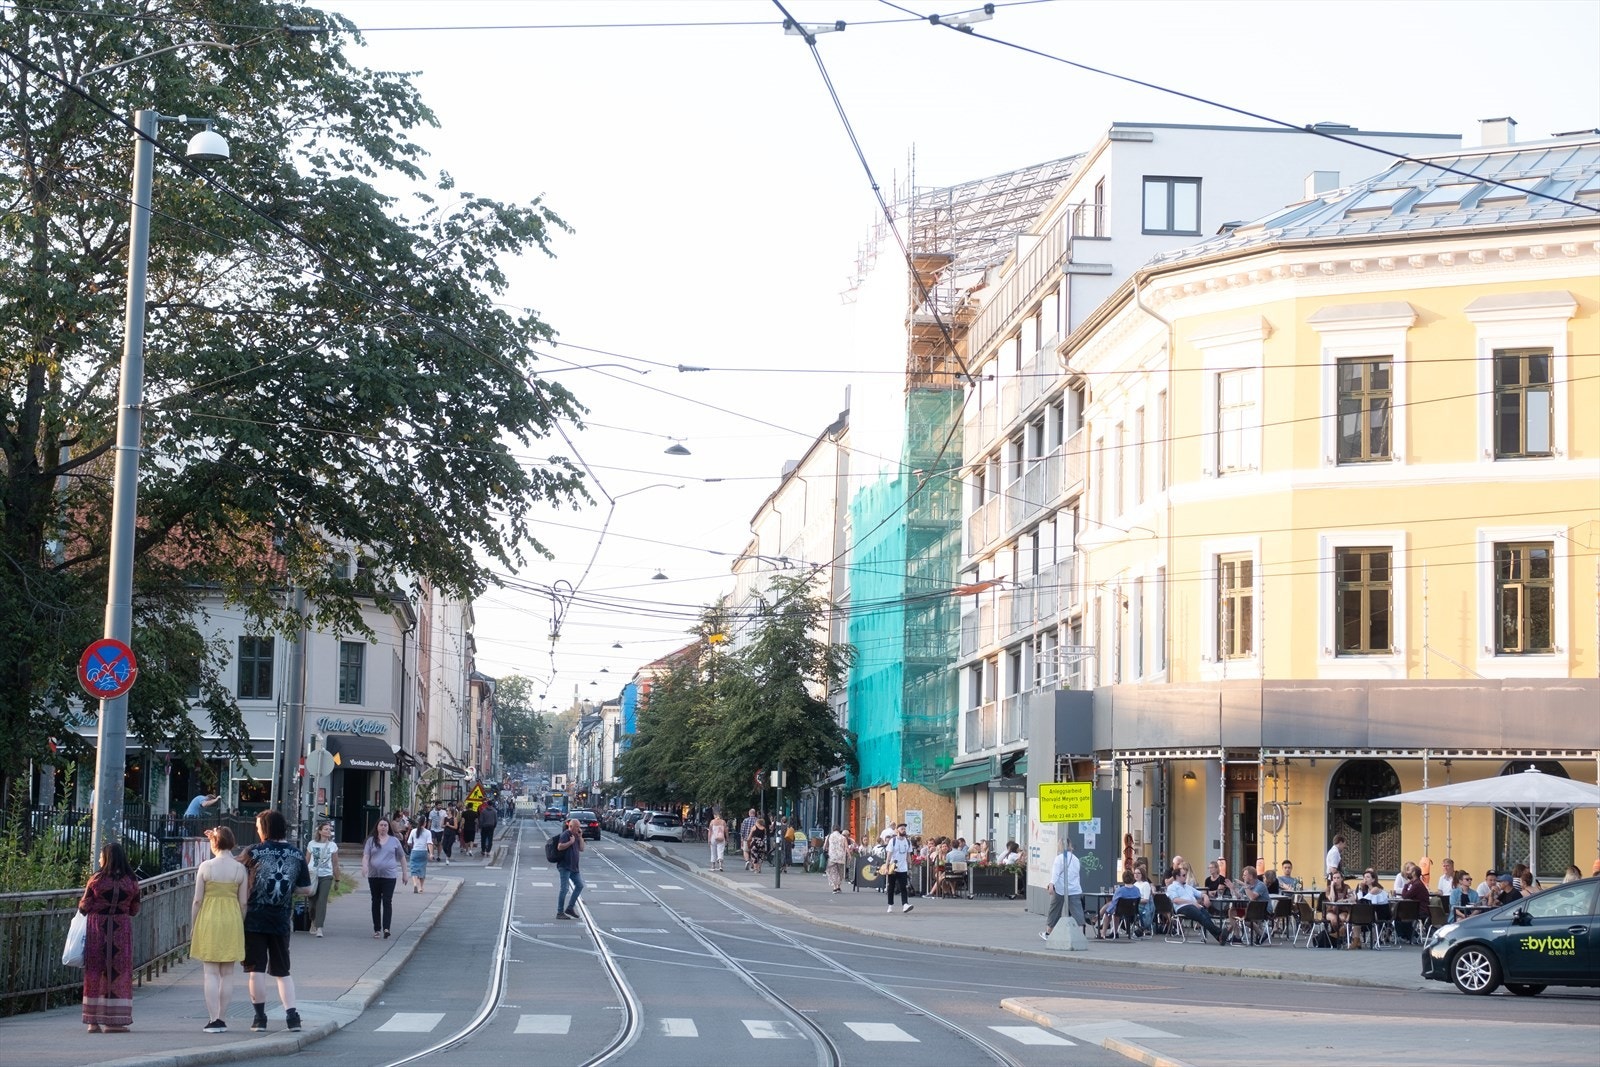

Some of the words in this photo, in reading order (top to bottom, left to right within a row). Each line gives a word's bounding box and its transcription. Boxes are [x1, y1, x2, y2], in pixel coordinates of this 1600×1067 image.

[317, 717, 350, 733] Nedre
[380, 761, 395, 769] Lounge
[251, 847, 281, 860] Archaic
[1529, 936, 1575, 952] bytaxi
